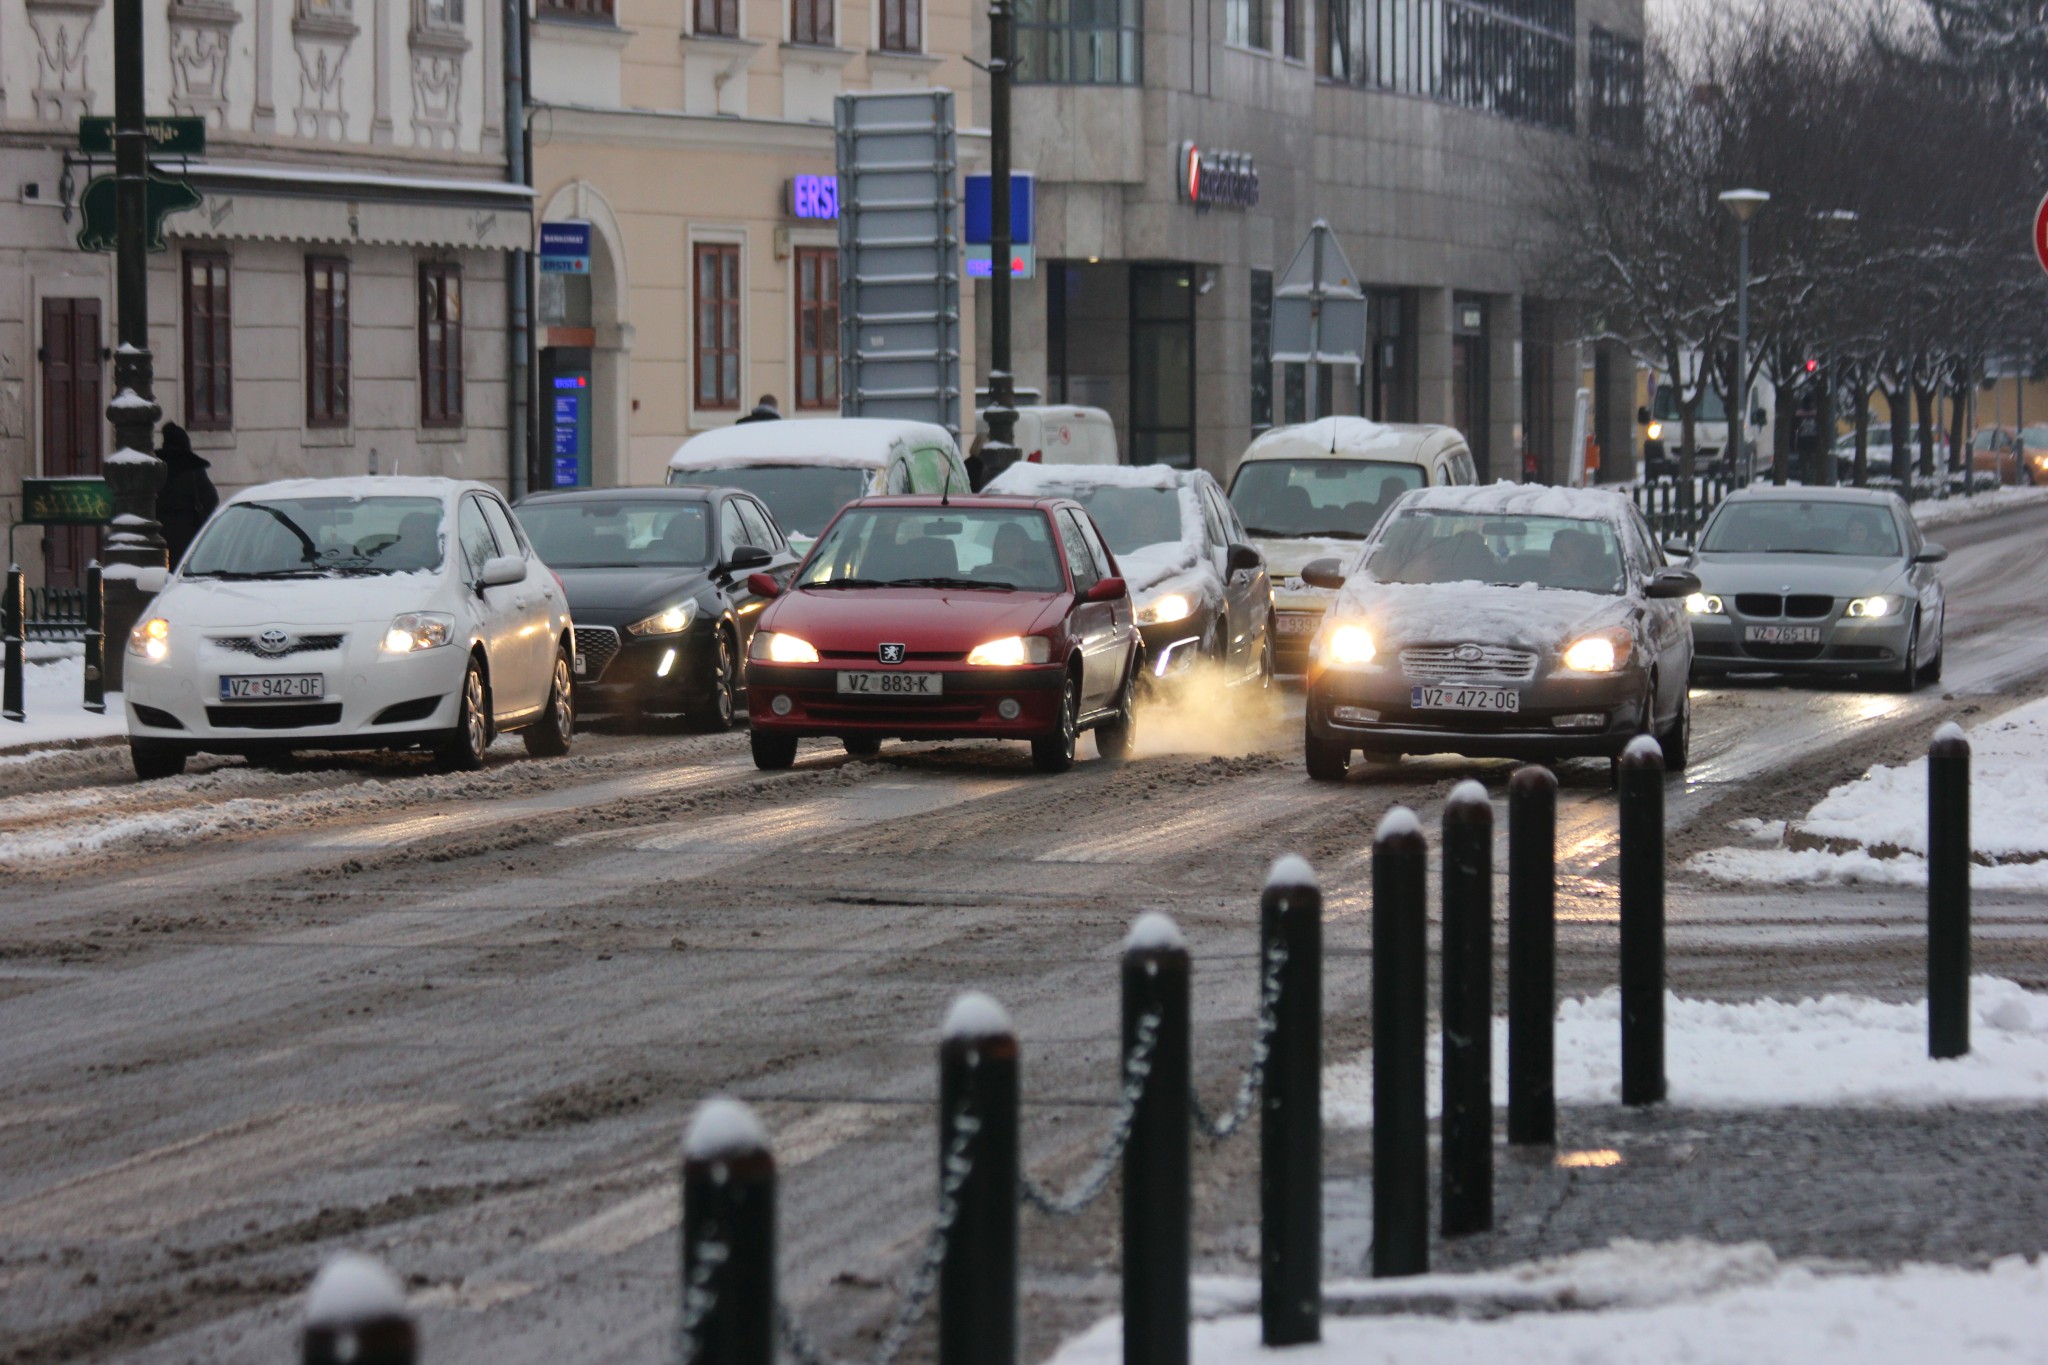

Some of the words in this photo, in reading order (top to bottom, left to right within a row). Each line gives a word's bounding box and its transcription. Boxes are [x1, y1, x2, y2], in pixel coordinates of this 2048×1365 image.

[795, 174, 838, 219] ERST
[262, 678, 320, 696] 942-OF
[881, 675, 928, 692] 883-K
[1456, 690, 1516, 709] 472-OG
